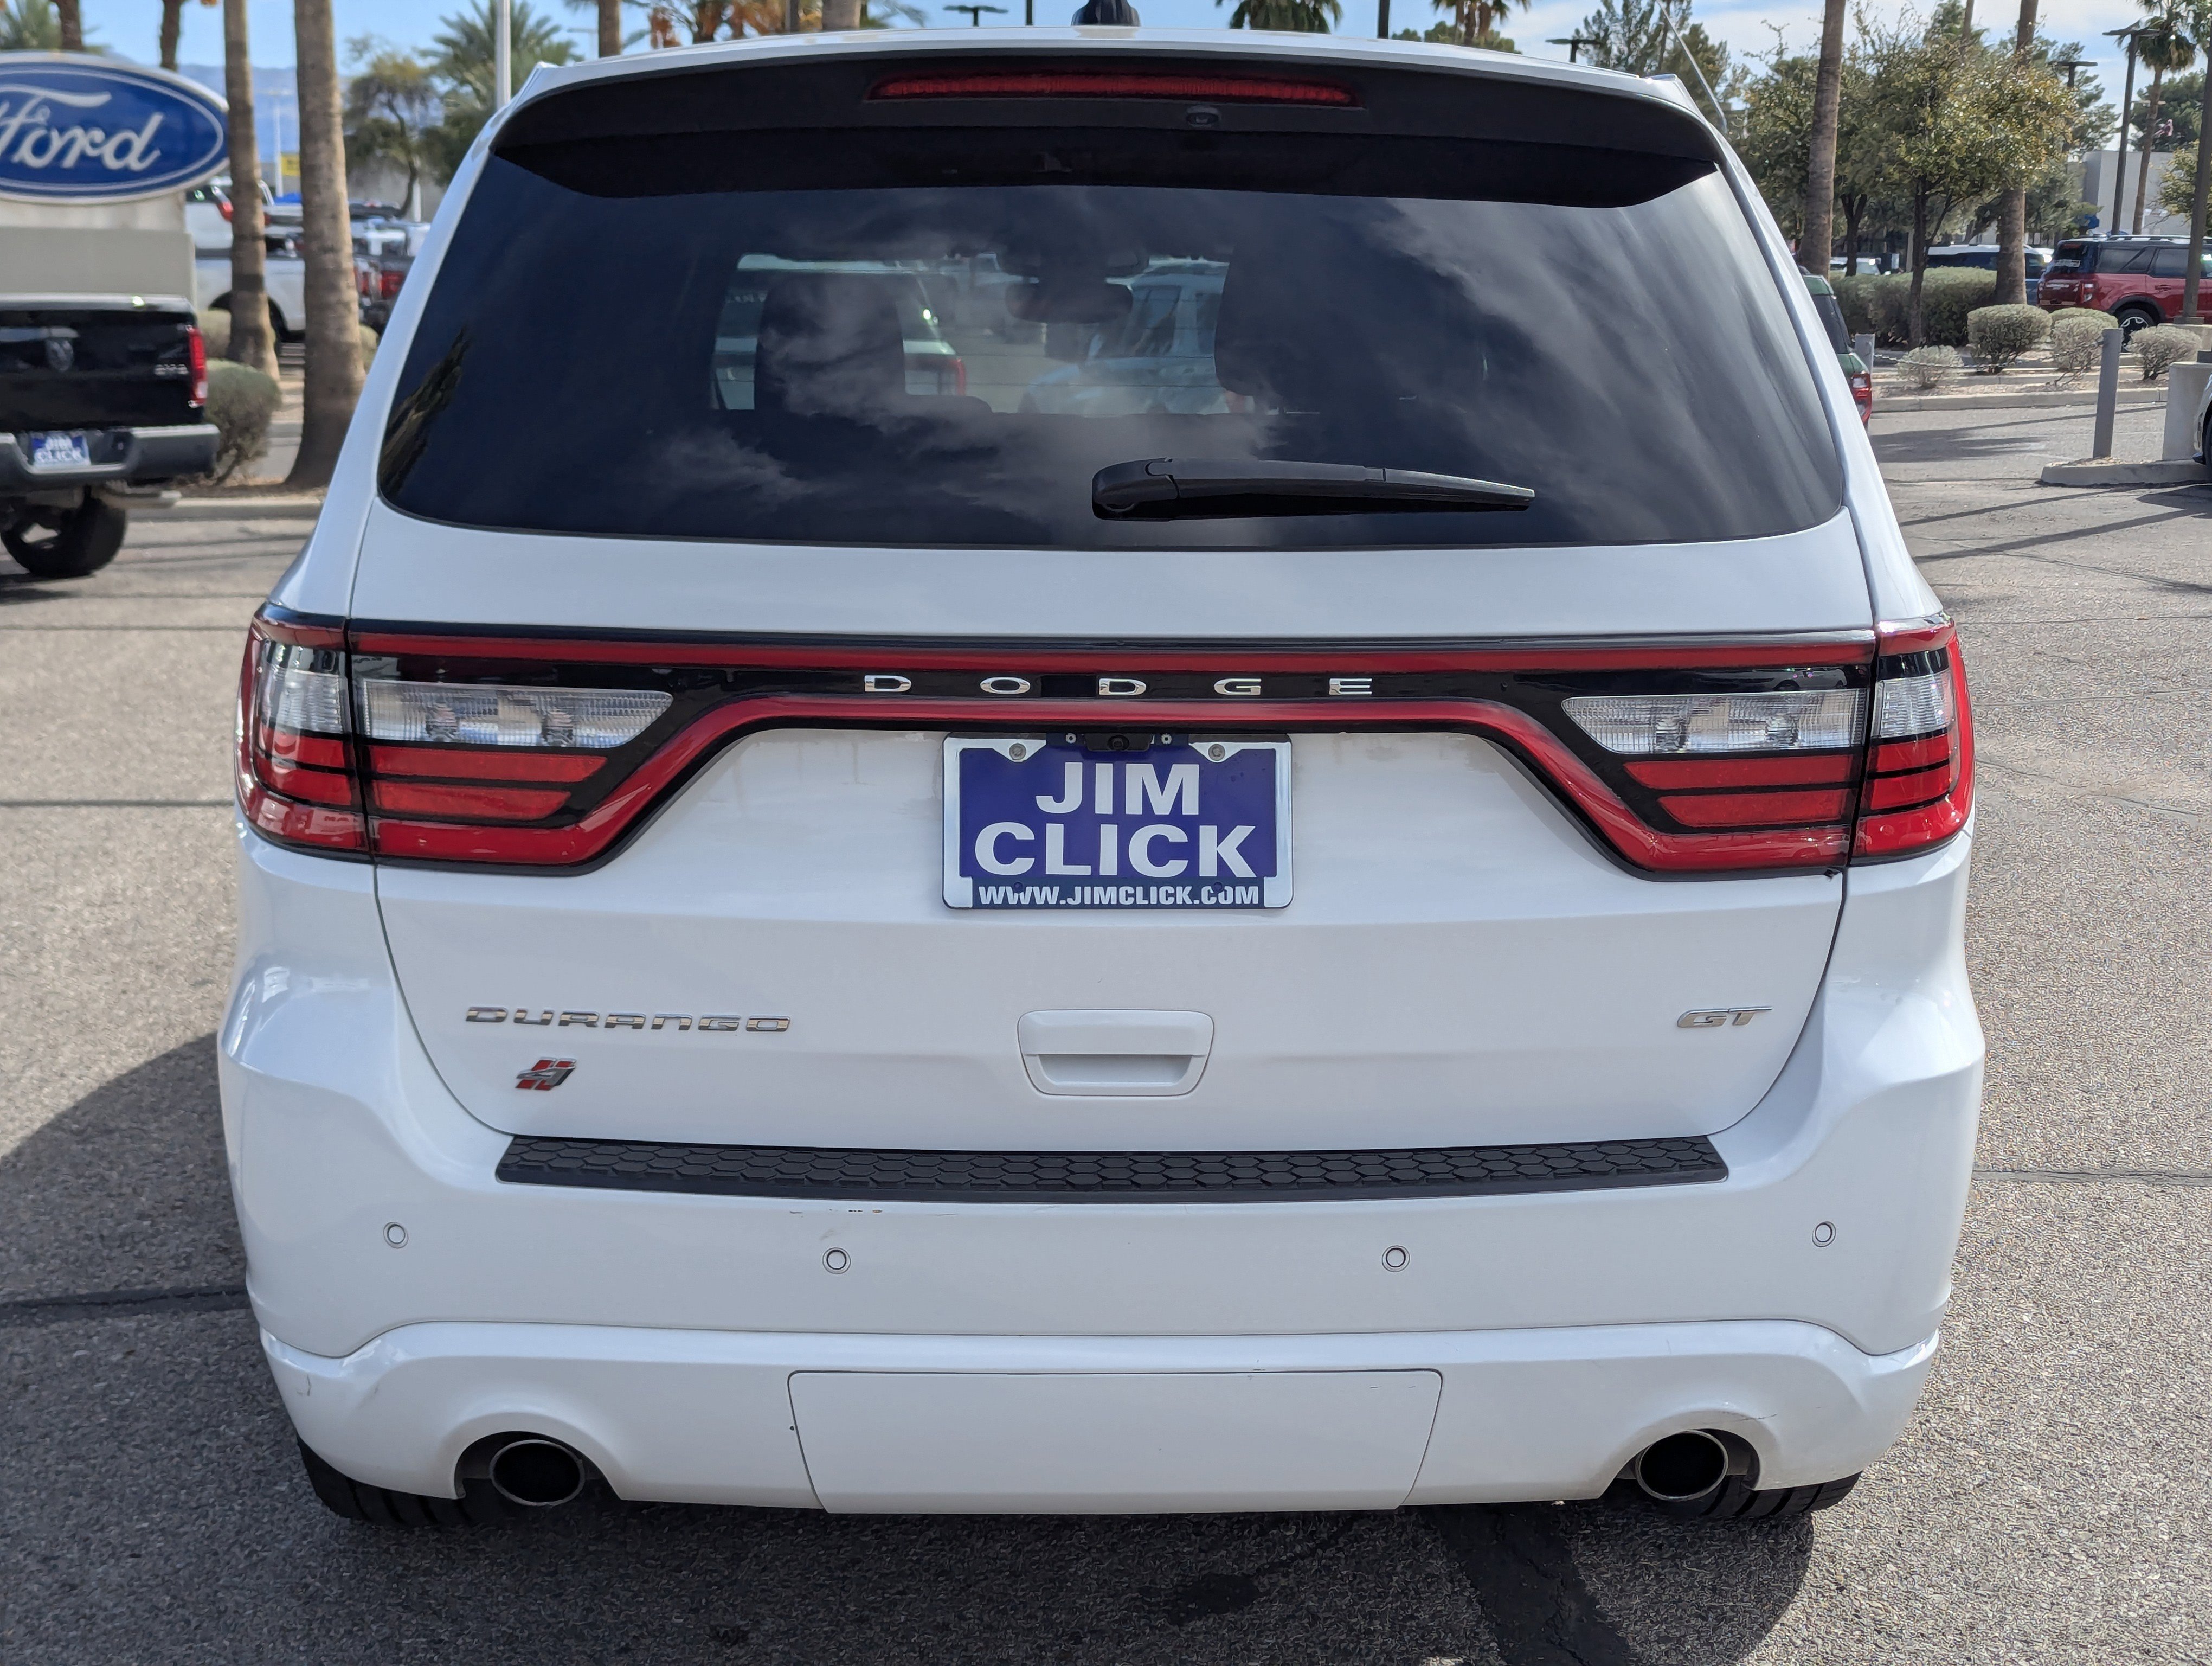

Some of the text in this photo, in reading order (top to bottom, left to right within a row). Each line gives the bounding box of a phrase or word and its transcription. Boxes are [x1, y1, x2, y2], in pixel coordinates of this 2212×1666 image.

[864, 674, 1372, 695] DODGE
[1036, 762, 1199, 815] JIM
[975, 822, 1257, 877] CLICK
[978, 886, 1259, 905] WWW.JIMCLICK.COM
[465, 1006, 791, 1032] DURANGO
[1677, 1006, 1772, 1028] GT
